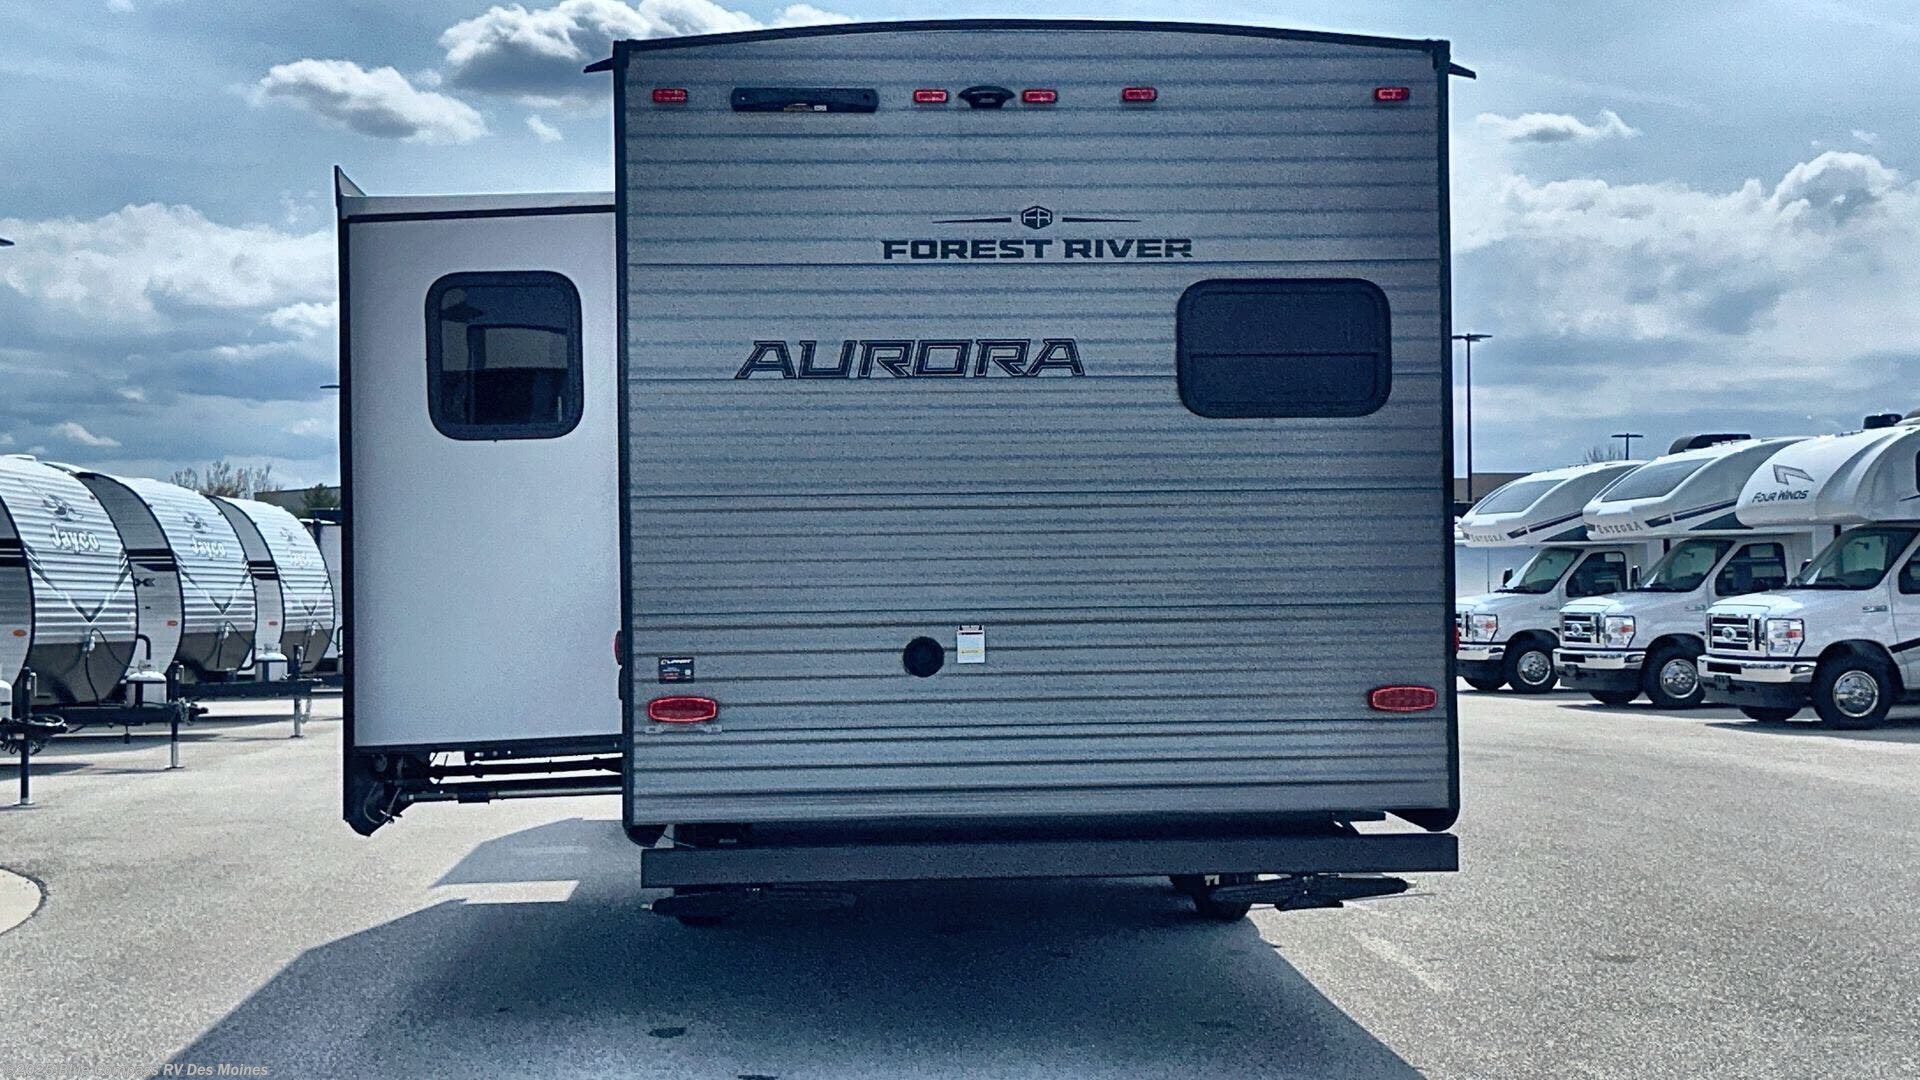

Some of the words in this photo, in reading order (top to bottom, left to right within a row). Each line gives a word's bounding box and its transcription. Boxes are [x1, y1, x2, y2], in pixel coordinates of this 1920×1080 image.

[881, 239, 1053, 260] FOREST
[1063, 238, 1193, 259] RIVER
[735, 339, 1085, 379] AURORA
[1752, 492, 1777, 503] FOUR
[1778, 490, 1809, 501] WINDS
[49, 523, 100, 554] Jayco
[190, 534, 227, 561] Jayco
